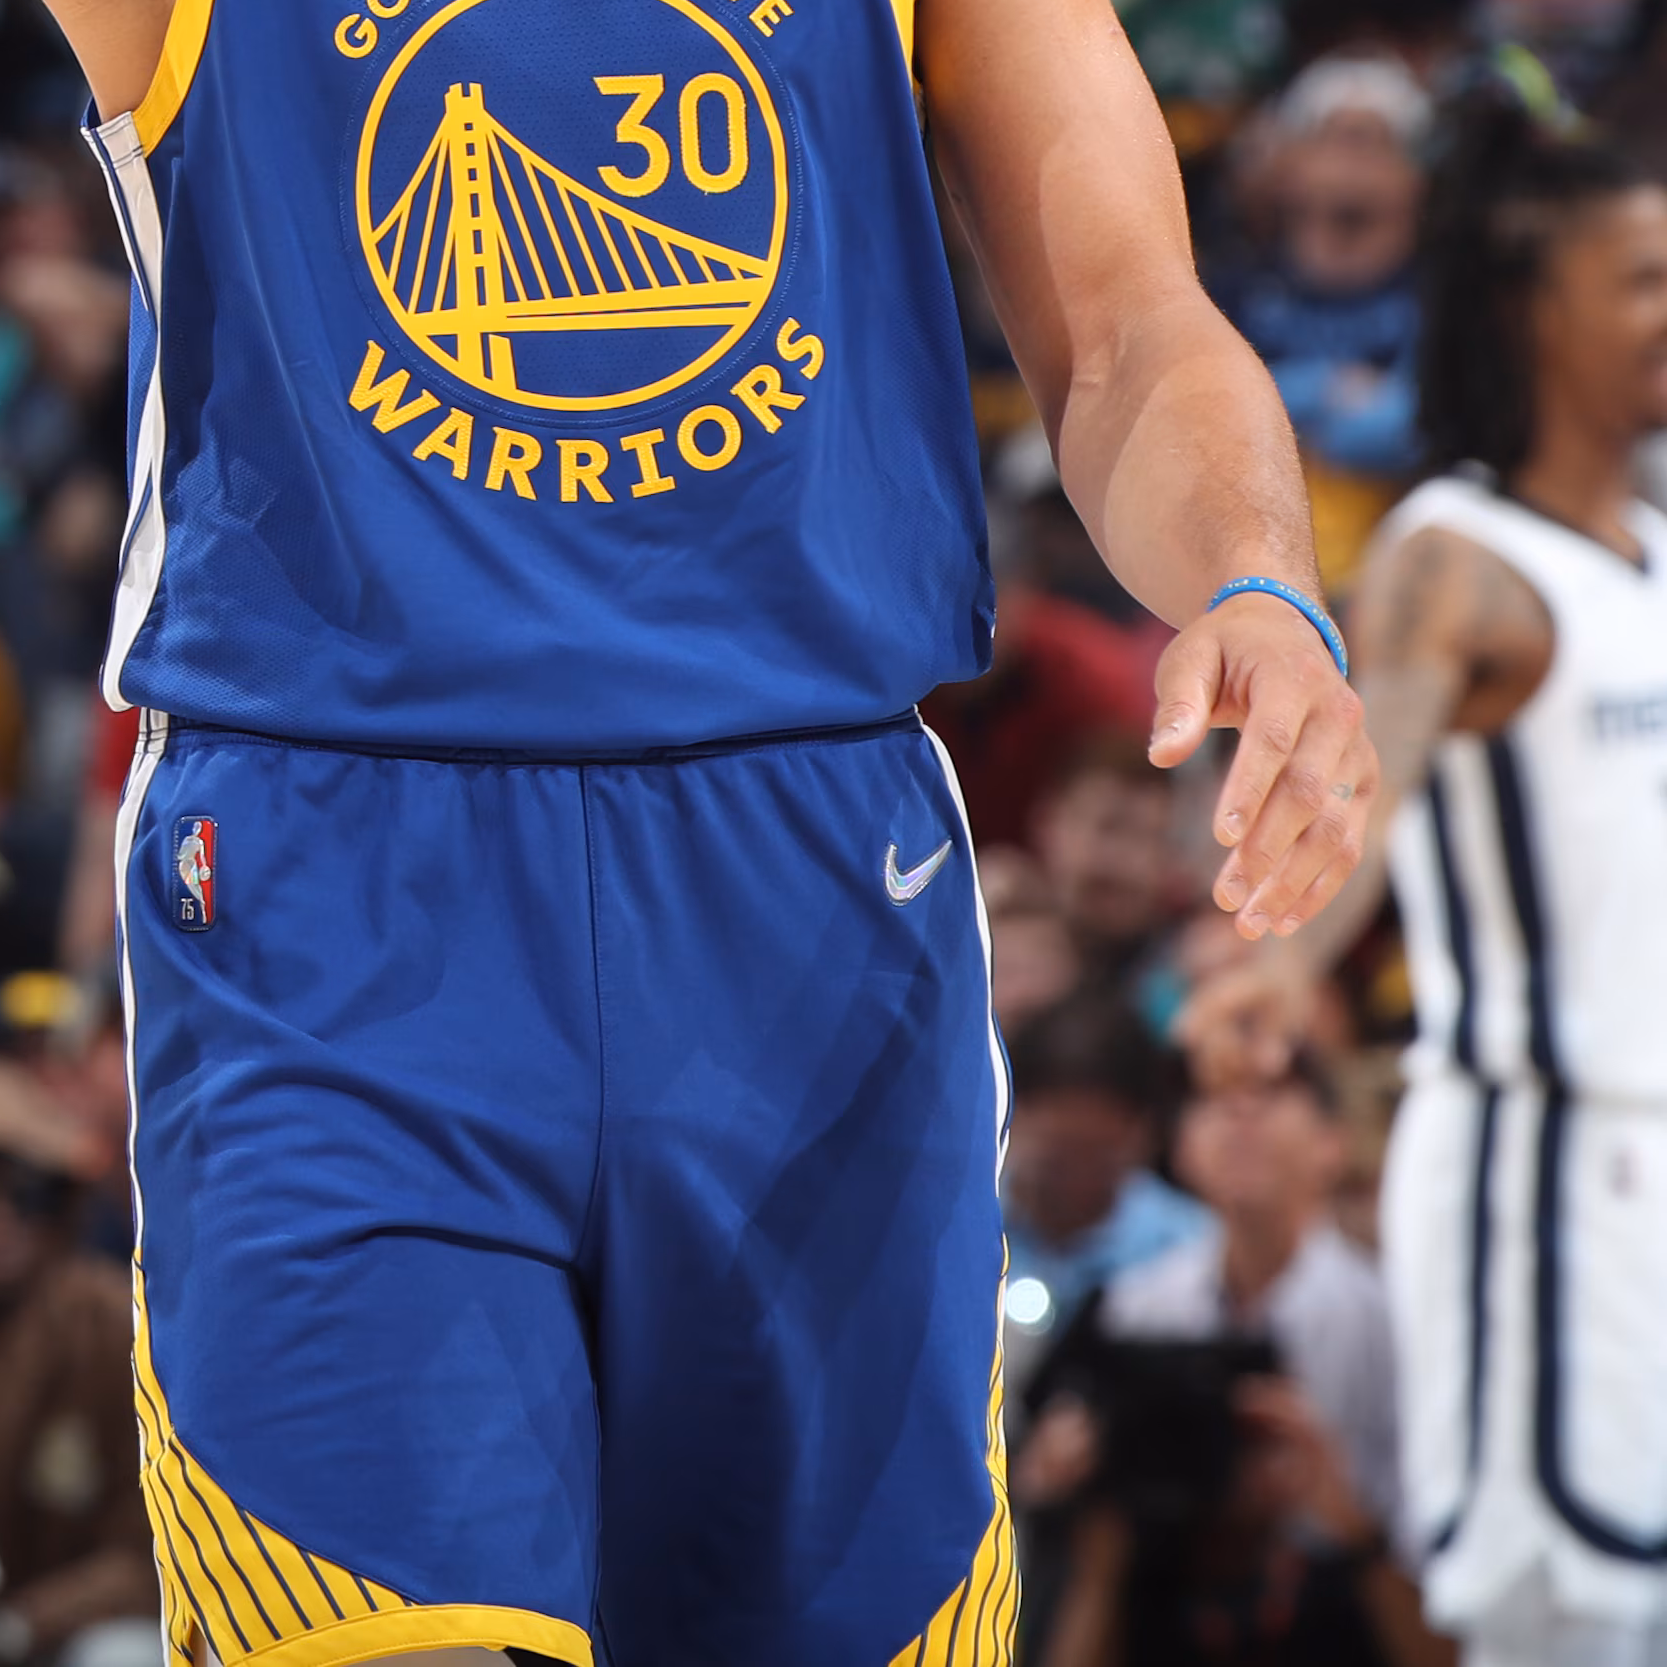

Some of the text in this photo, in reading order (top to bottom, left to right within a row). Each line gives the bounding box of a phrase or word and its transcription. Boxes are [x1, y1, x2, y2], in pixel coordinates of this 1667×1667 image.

[593, 72, 749, 197] 30
[348, 317, 825, 503] WARRIORS
[180, 897, 195, 921] 75
